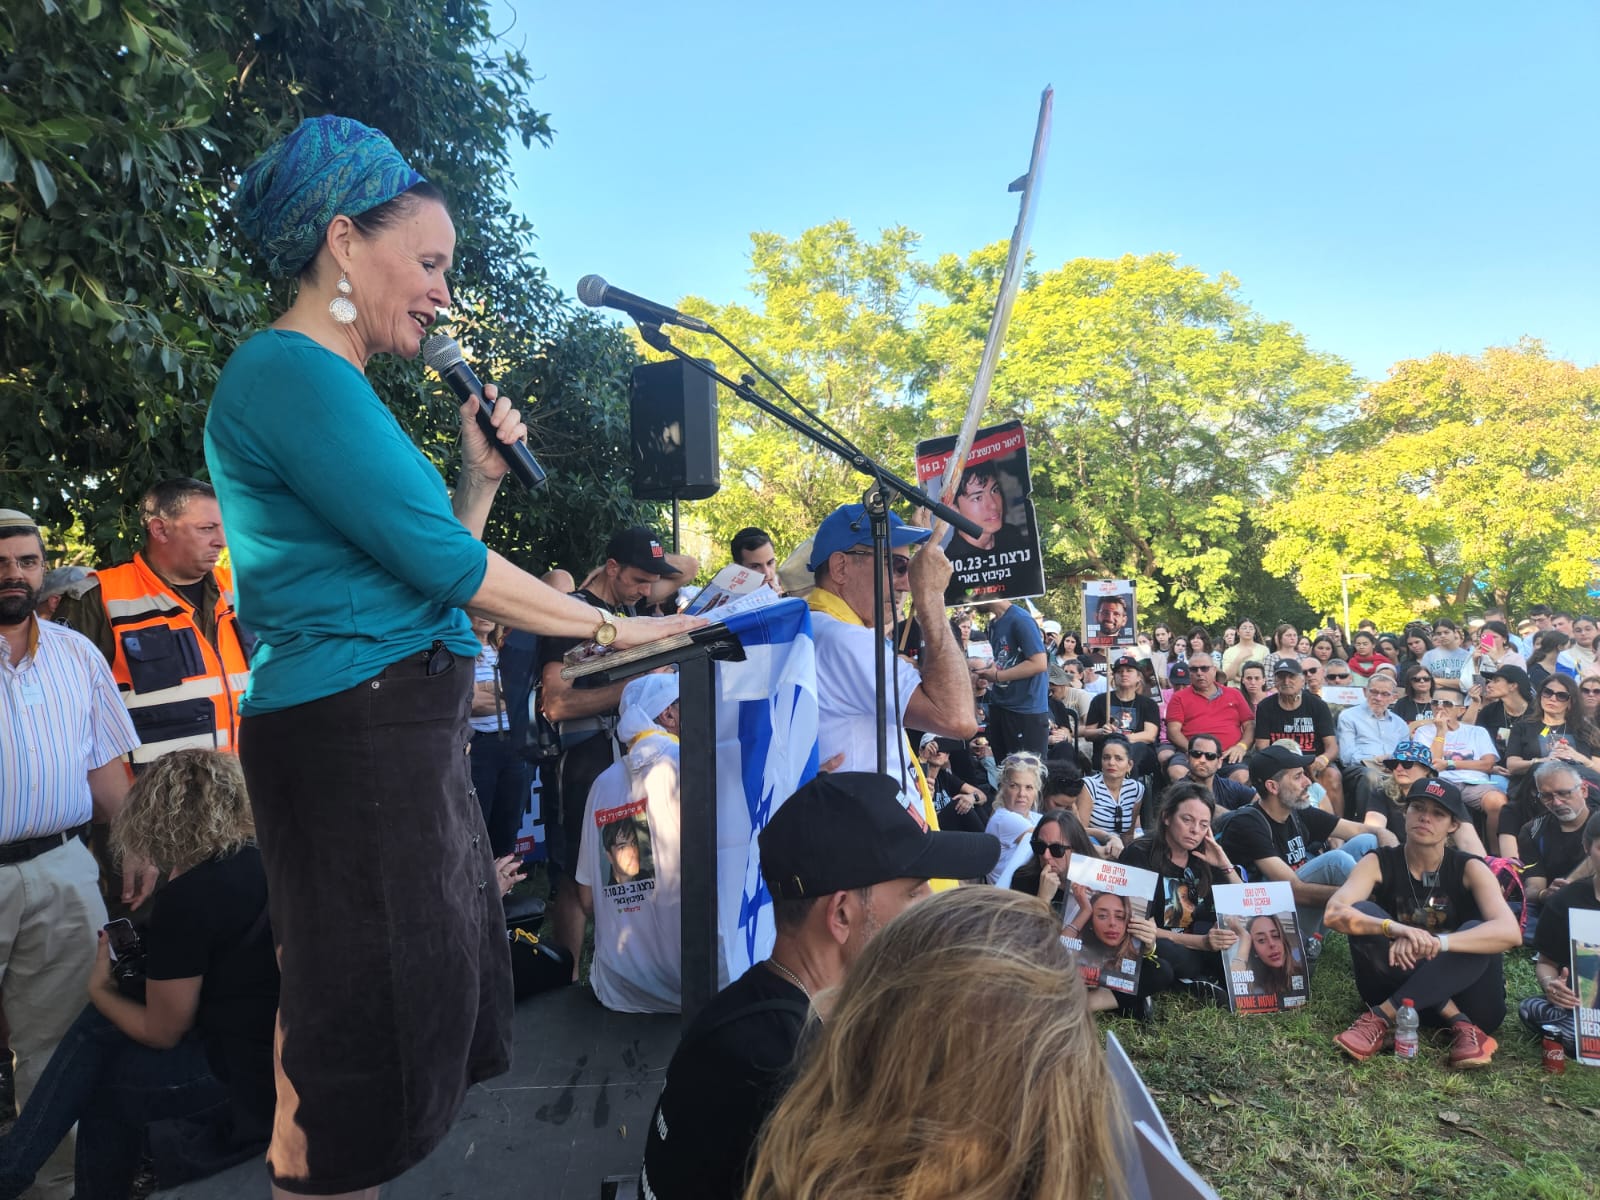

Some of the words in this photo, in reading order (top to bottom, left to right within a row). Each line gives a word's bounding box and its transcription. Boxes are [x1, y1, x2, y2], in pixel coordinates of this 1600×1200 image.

[920, 463, 931, 474] 16
[1000, 549, 1031, 566] נרצח
[958, 573, 980, 584] בארי
[982, 568, 1012, 583] בקיבוץ
[1095, 873, 1107, 882] MIA
[1107, 875, 1128, 887] SCHEM
[1231, 969, 1255, 983] BRING
[1233, 983, 1249, 995] HER
[1235, 996, 1255, 1009] HOME
[1257, 992, 1278, 1008] NOW!
